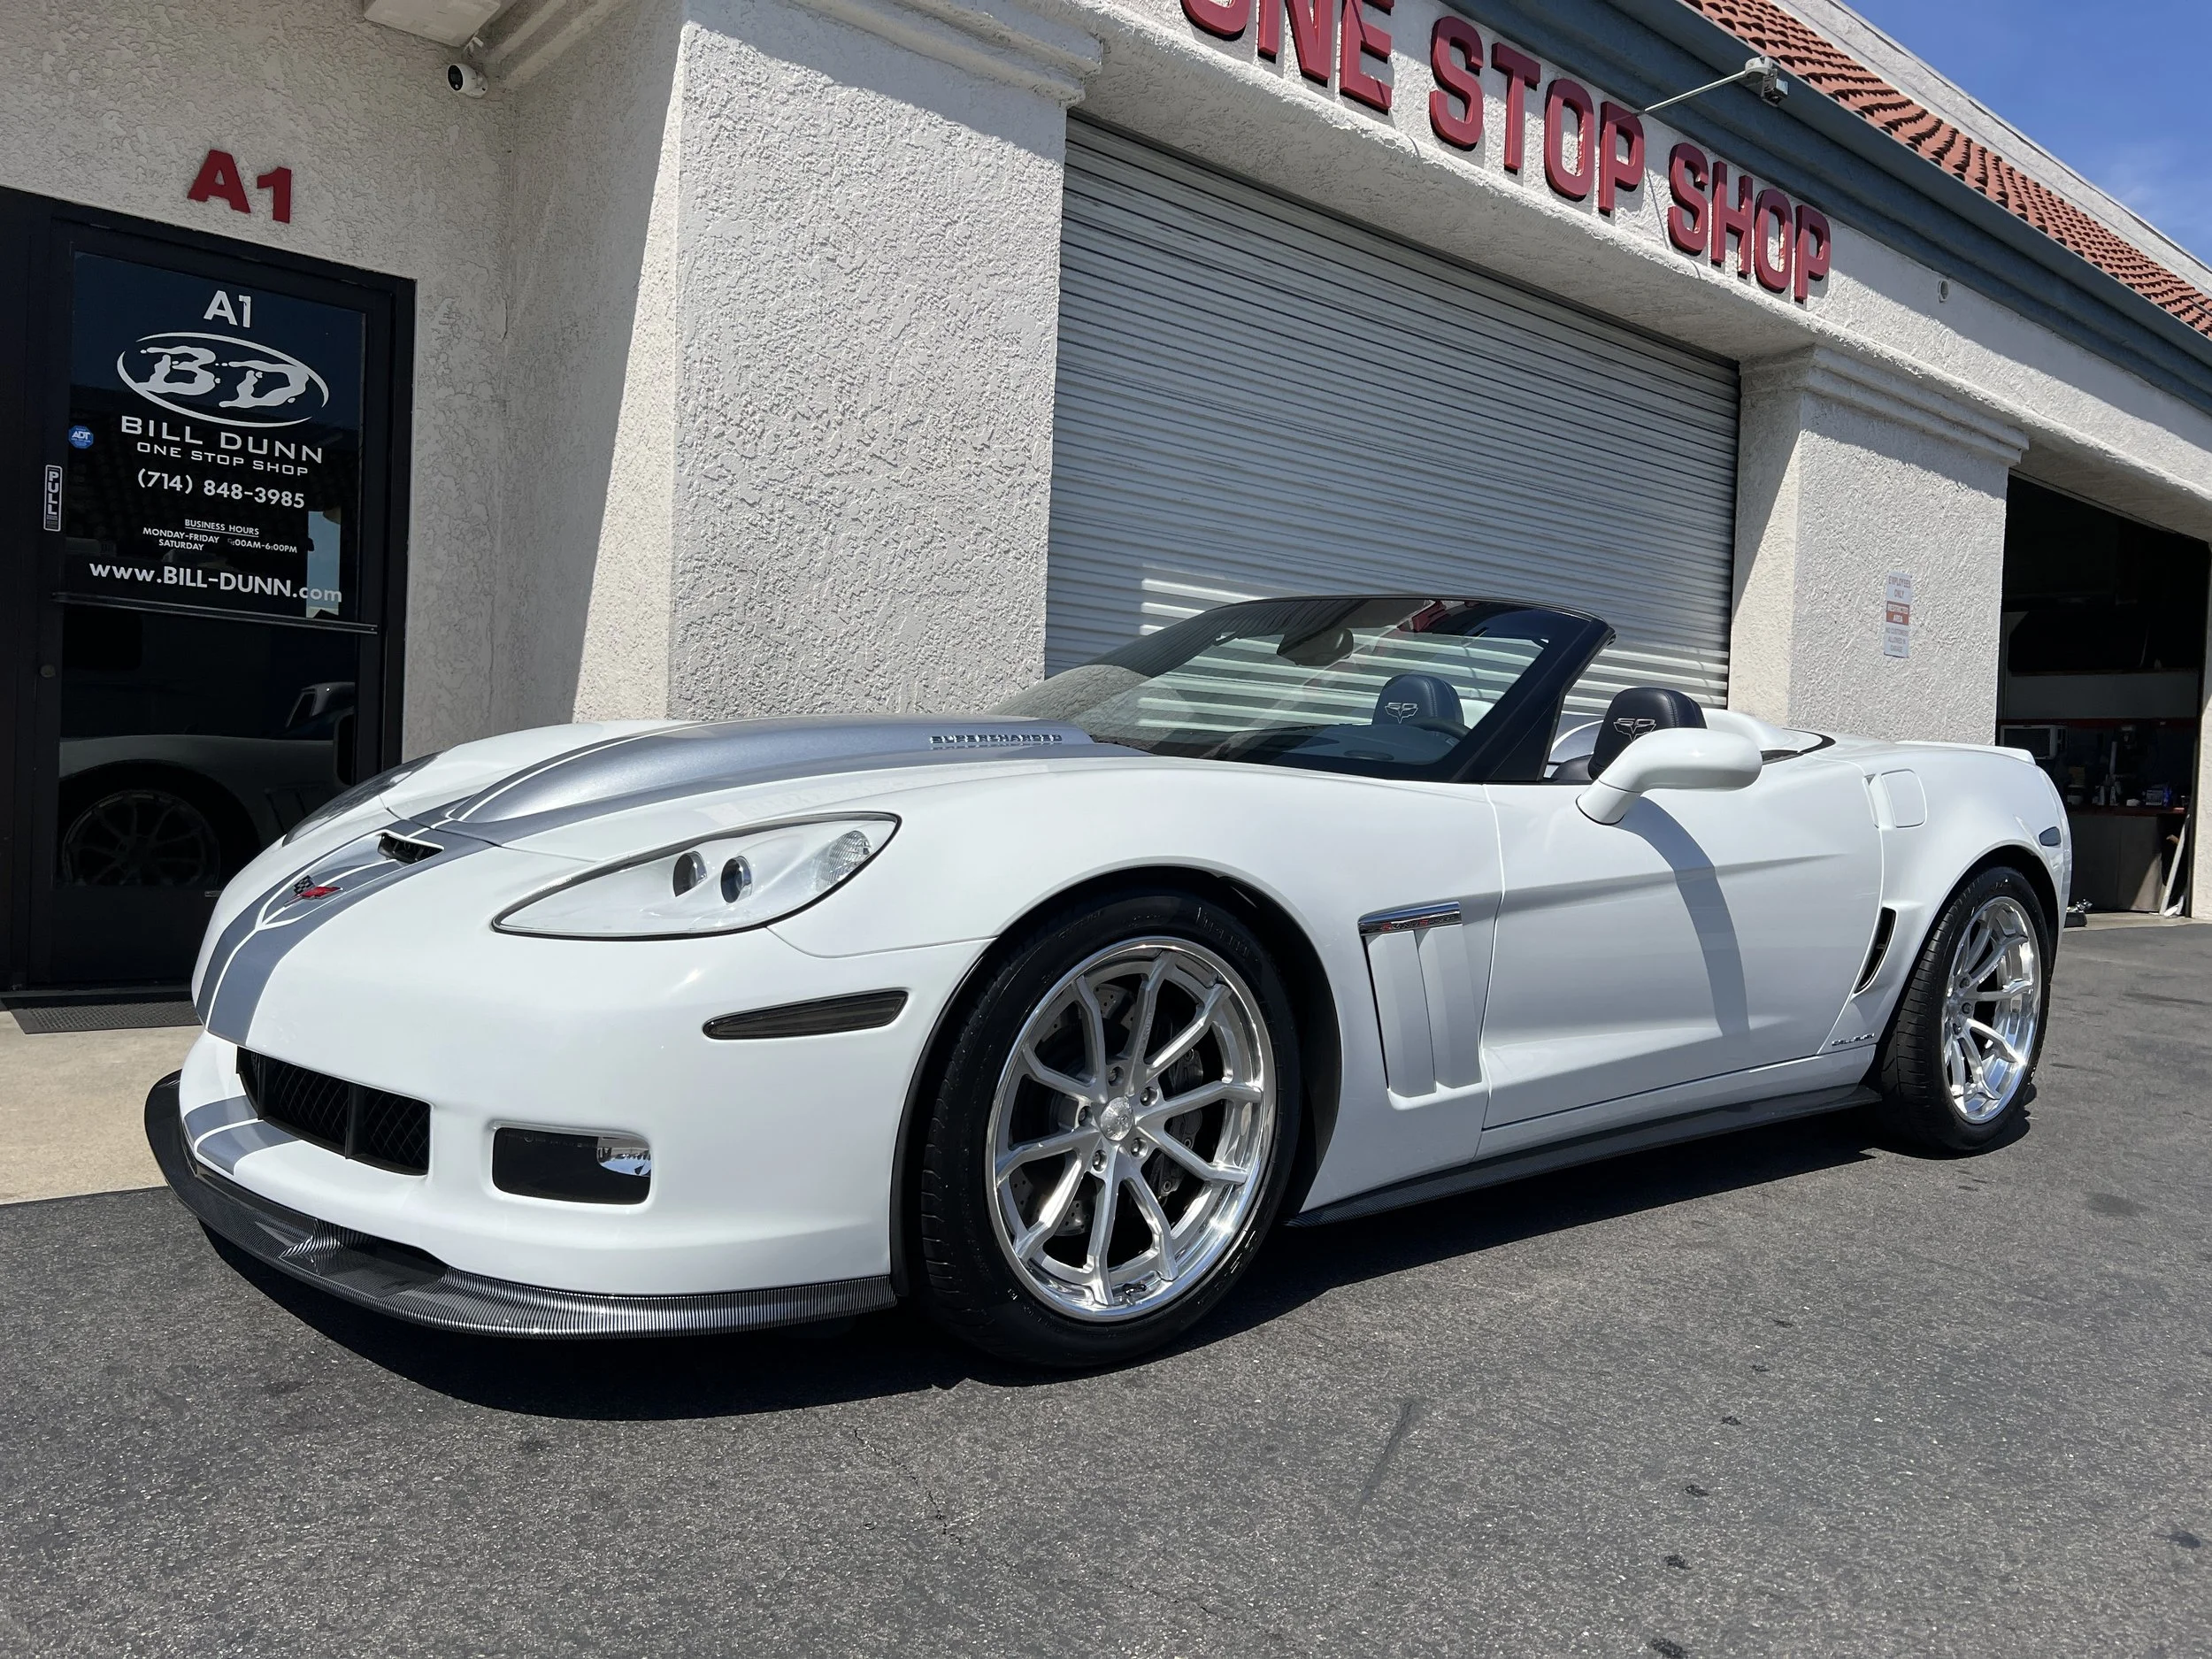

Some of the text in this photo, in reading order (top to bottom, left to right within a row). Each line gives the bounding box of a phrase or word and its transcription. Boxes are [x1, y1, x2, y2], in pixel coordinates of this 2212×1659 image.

[1183, 0, 1831, 303] NE STOP SHOP
[187, 149, 293, 225] A1
[204, 290, 251, 328] A1
[72, 431, 91, 441] ADT
[121, 415, 322, 464] BILL DUNN
[137, 442, 308, 476] ONE STOP SHOP
[48, 471, 59, 515] PULL
[137, 468, 305, 509] (714) 848-3985
[142, 527, 220, 543] MONDAY-FRIDAY
[158, 539, 204, 551] SATURDAY
[184, 518, 260, 535] BUSINESS HOURS
[89, 563, 342, 603] www.BILL-DUNN.com
[1894, 589, 1904, 598] ONLY
